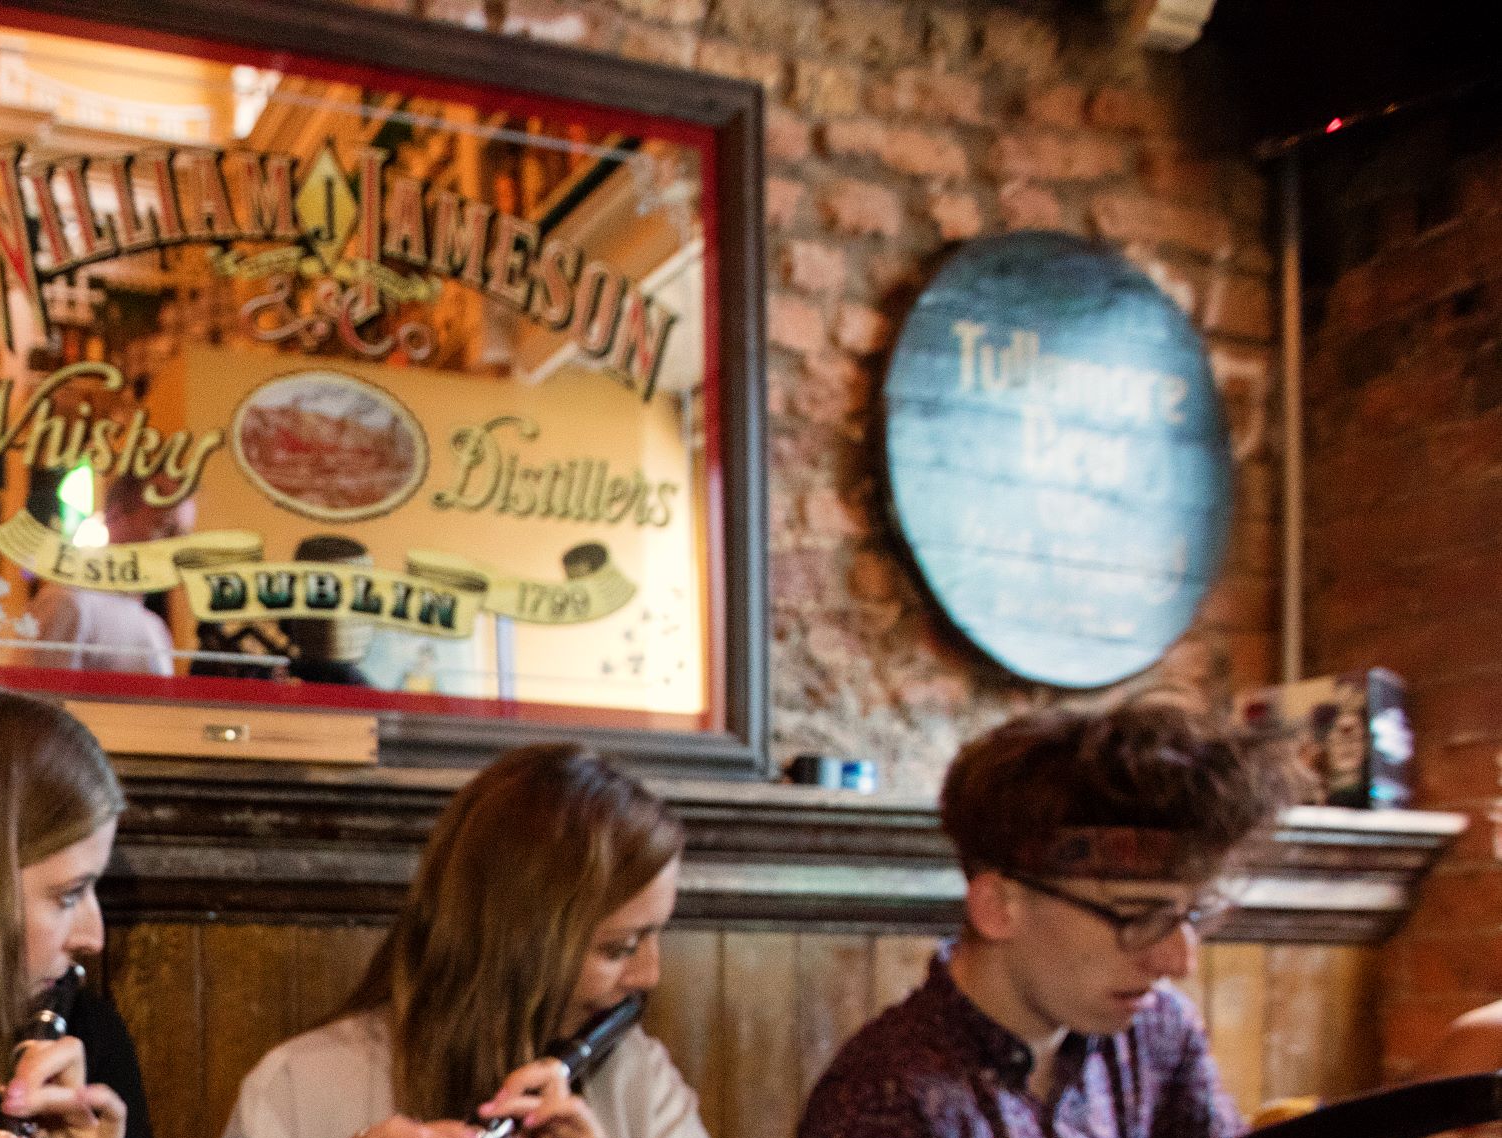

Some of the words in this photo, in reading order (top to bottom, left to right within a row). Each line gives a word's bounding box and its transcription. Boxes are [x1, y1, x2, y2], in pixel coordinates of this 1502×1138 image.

[351, 148, 680, 403] JAMESON
[431, 414, 679, 528] Distillers
[205, 569, 457, 630] DUBLIN
